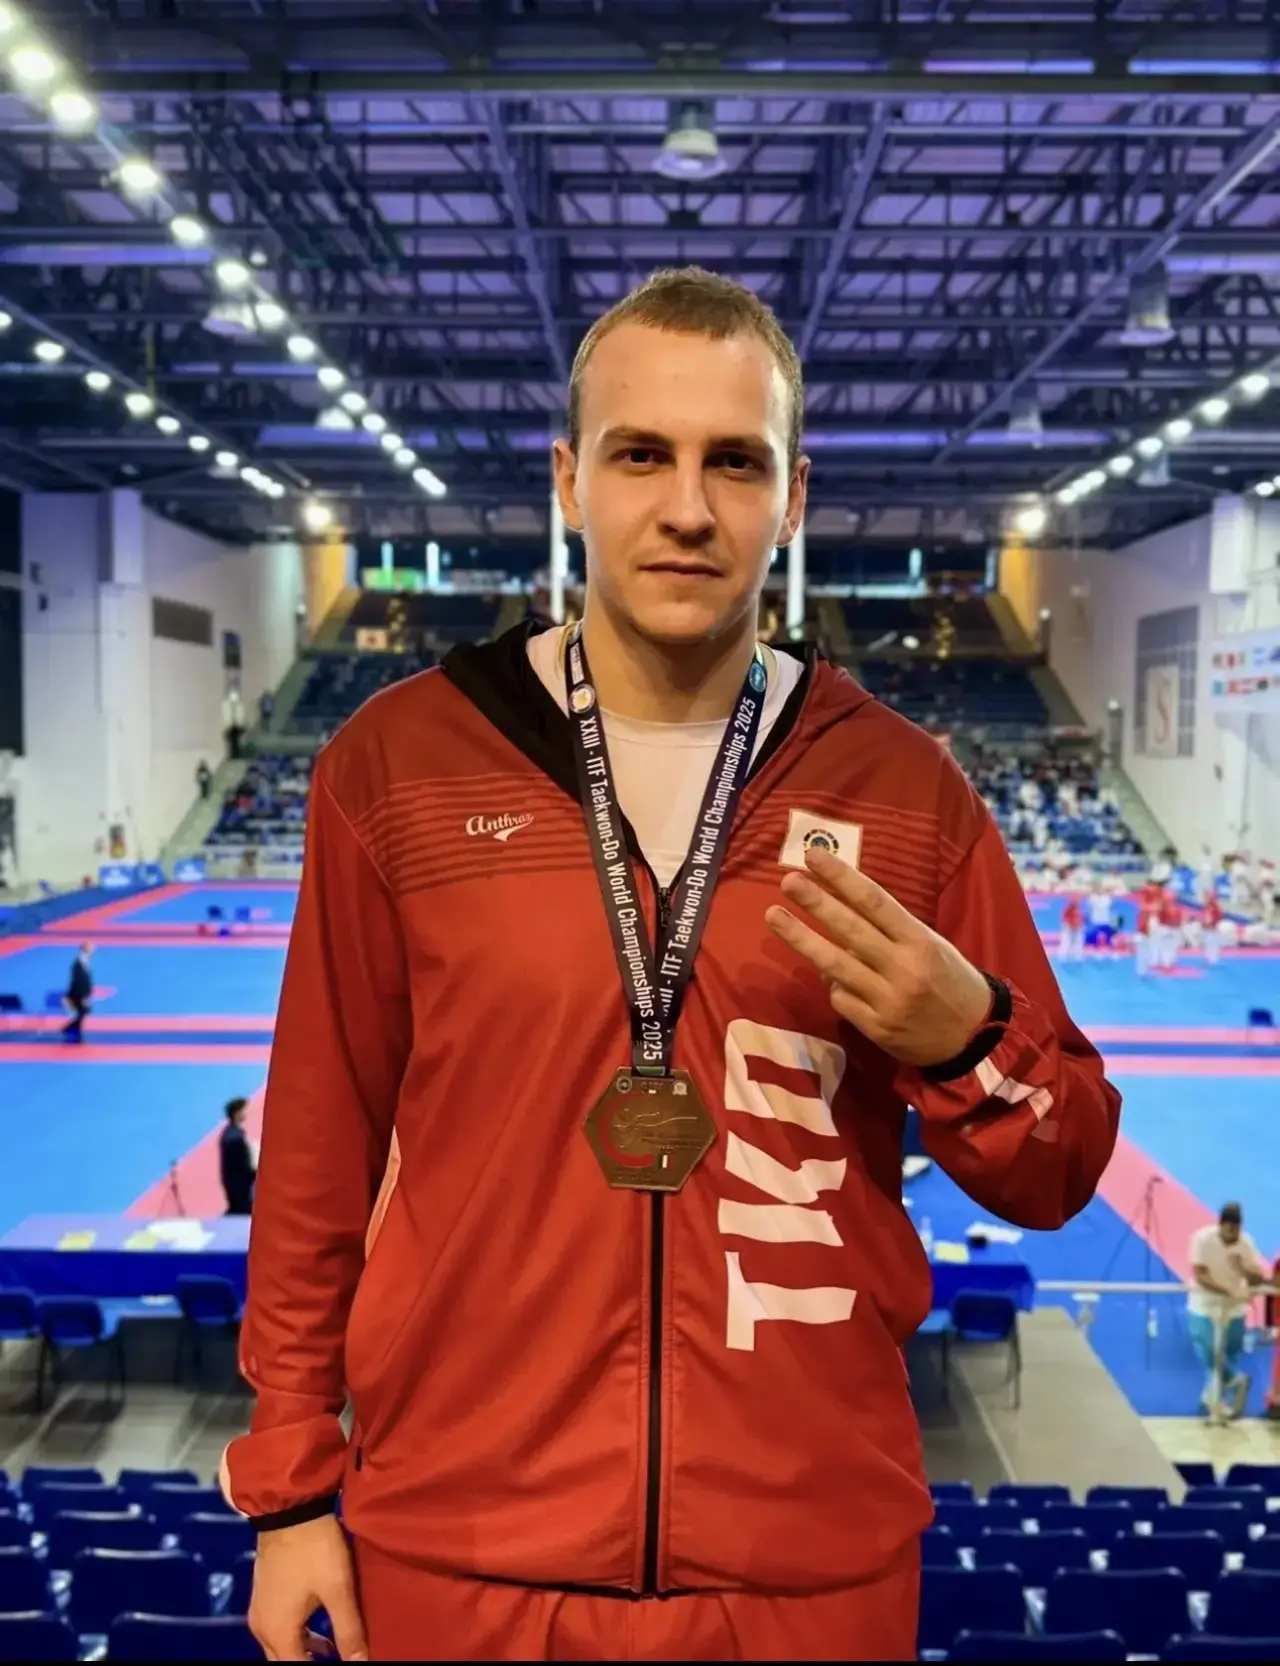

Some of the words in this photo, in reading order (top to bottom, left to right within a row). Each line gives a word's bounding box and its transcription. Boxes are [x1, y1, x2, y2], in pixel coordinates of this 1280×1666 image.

[580, 716, 601, 748] XXIII
[734, 696, 756, 732] 2025
[586, 756, 606, 777] ITF
[704, 732, 748, 824] Championships
[590, 778, 620, 860] Taekwon-Do
[692, 826, 719, 865] World
[607, 862, 634, 905] World
[667, 868, 708, 949] Taekwon-Do
[617, 908, 655, 1017] Championships
[660, 953, 683, 976] ITF
[641, 1021, 662, 1060] 2025
[718, 1018, 857, 1352] TKD
